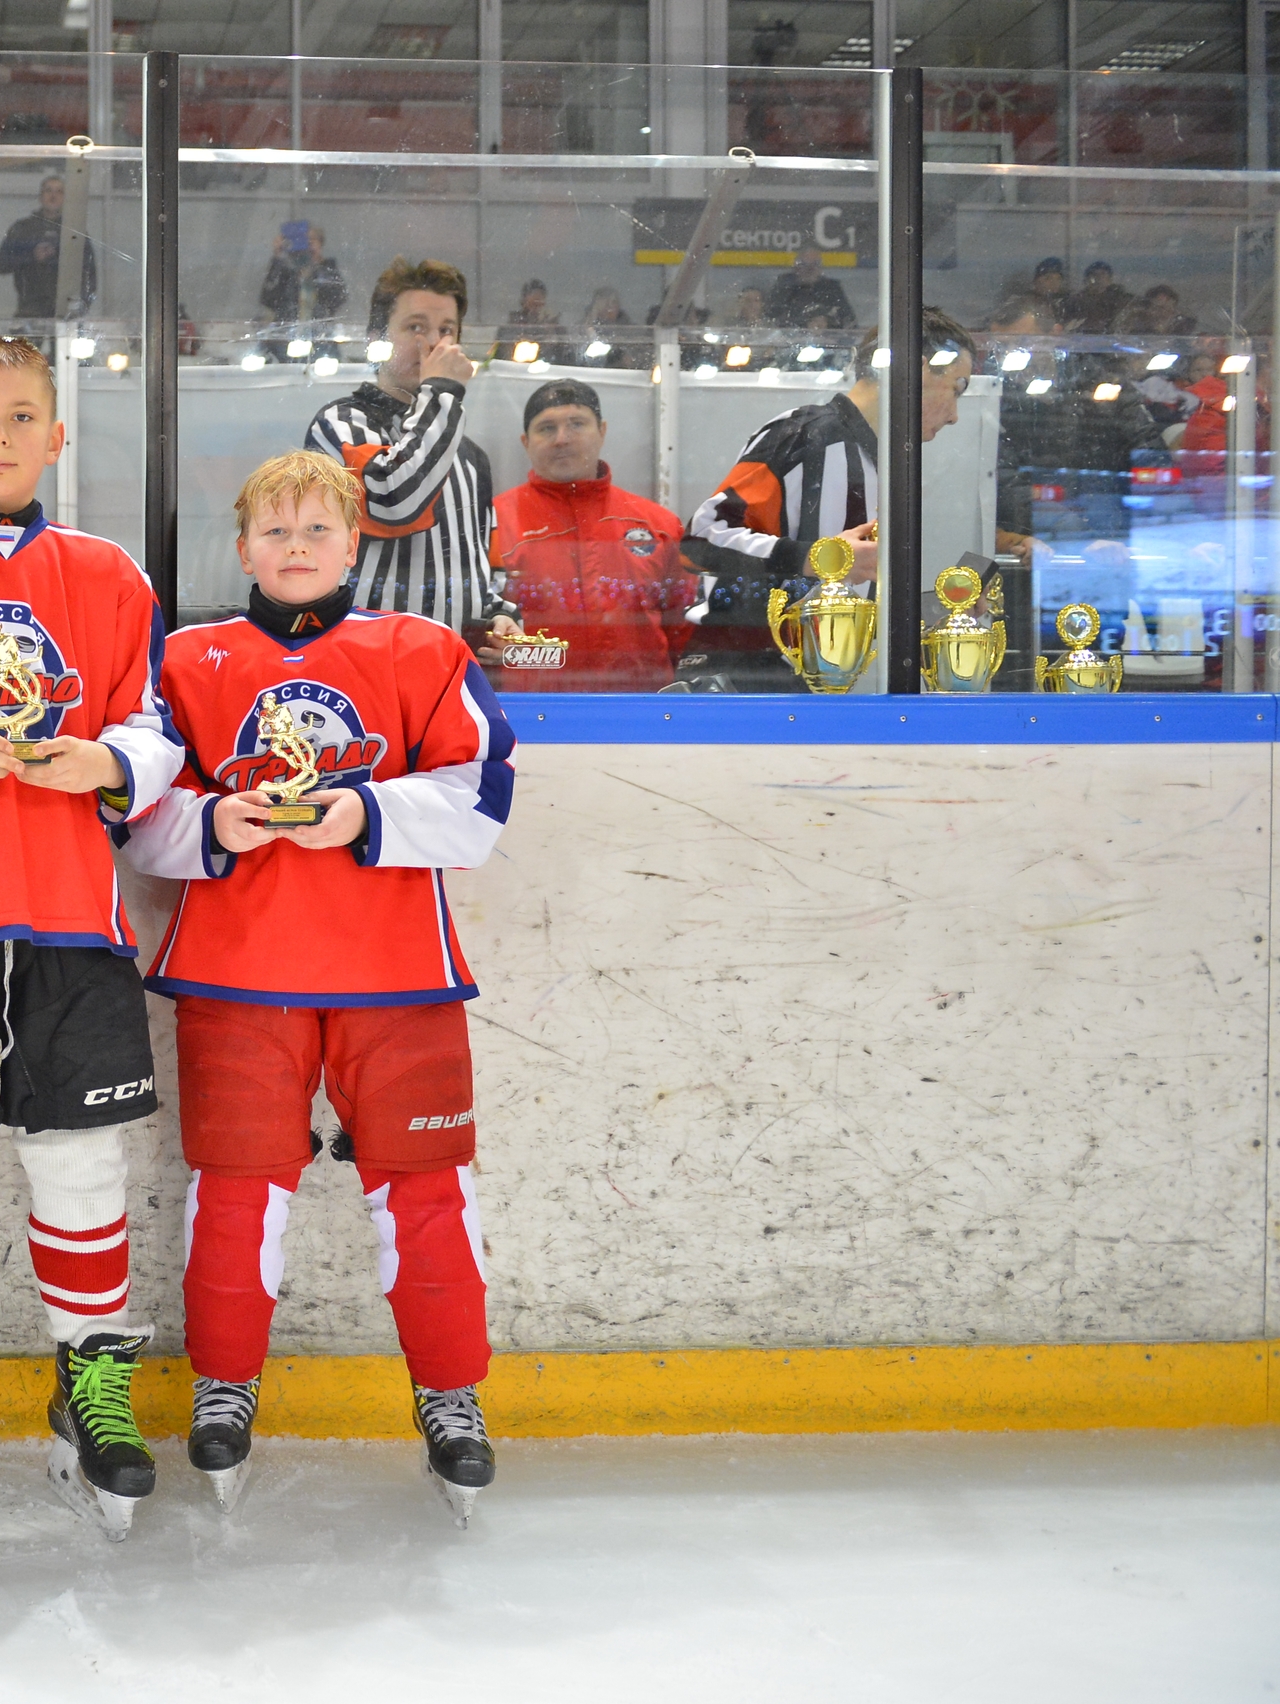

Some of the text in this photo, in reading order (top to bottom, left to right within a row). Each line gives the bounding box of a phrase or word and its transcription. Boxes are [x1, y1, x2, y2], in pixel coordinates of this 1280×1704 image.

[516, 647, 562, 664] RAITA
[254, 685, 348, 718] РССИЯ
[83, 1074, 154, 1106] CCM
